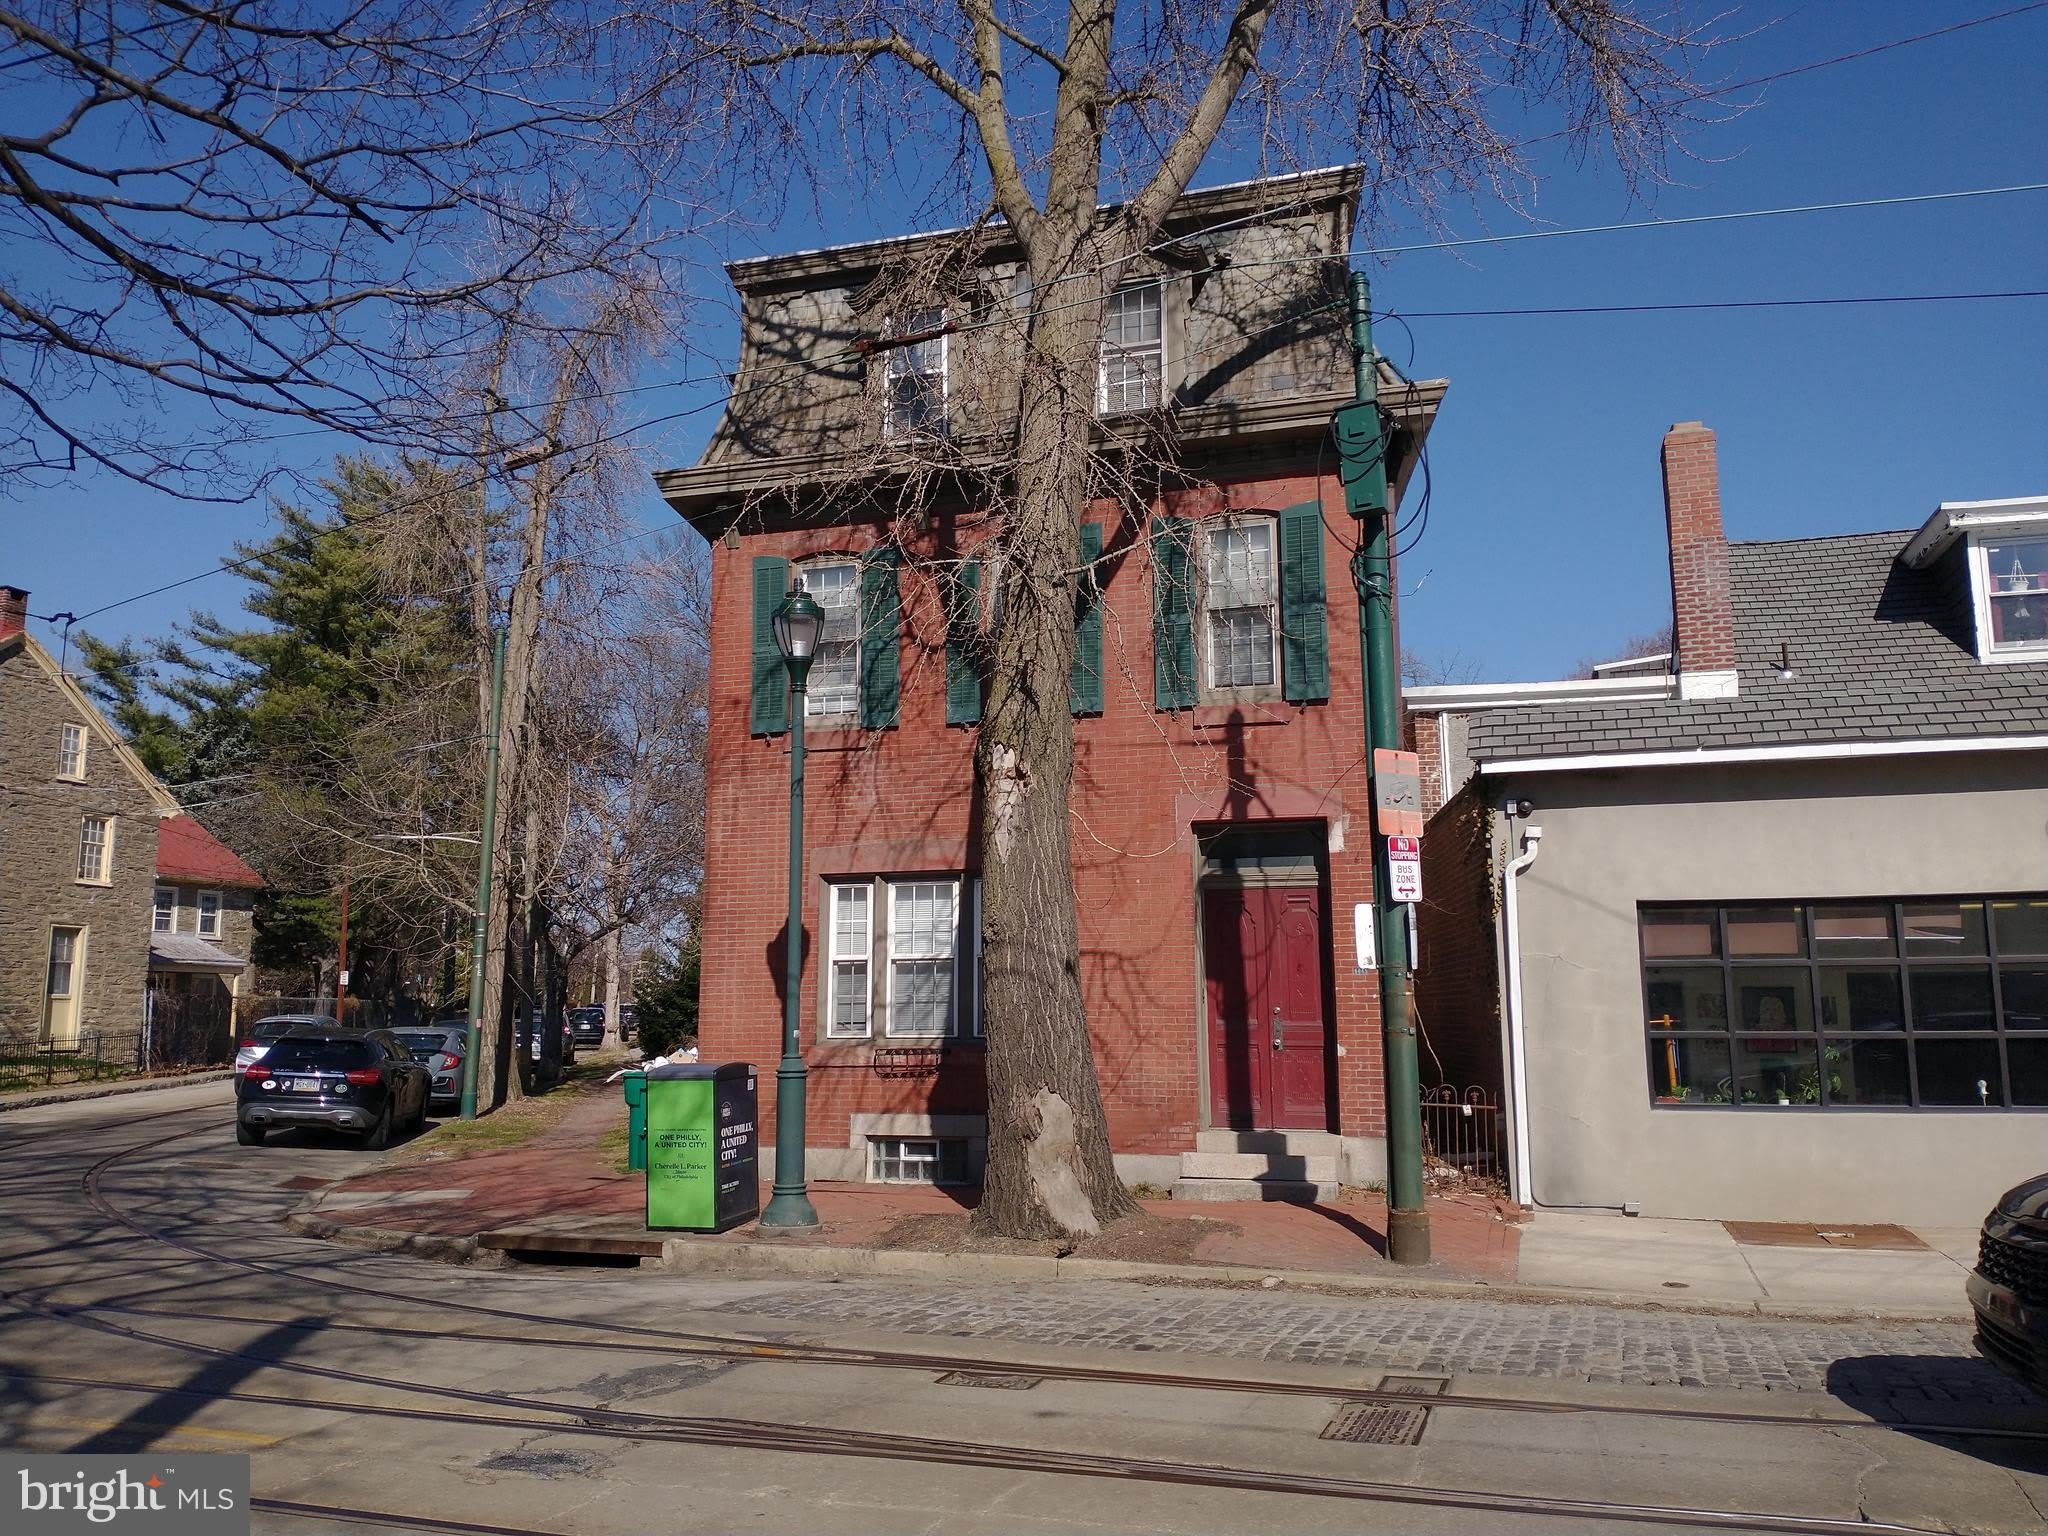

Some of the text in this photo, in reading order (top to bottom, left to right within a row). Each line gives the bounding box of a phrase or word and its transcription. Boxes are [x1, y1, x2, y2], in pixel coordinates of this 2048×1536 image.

[1397, 838, 1409, 850] NO
[1390, 851, 1418, 860] STOPPING
[1397, 865, 1413, 874] BUS
[1396, 875, 1417, 884] ZONE
[721, 1122, 754, 1137] ONE PHILLY,
[721, 1134, 748, 1149] A UNITED
[721, 1149, 737, 1161] CITY!
